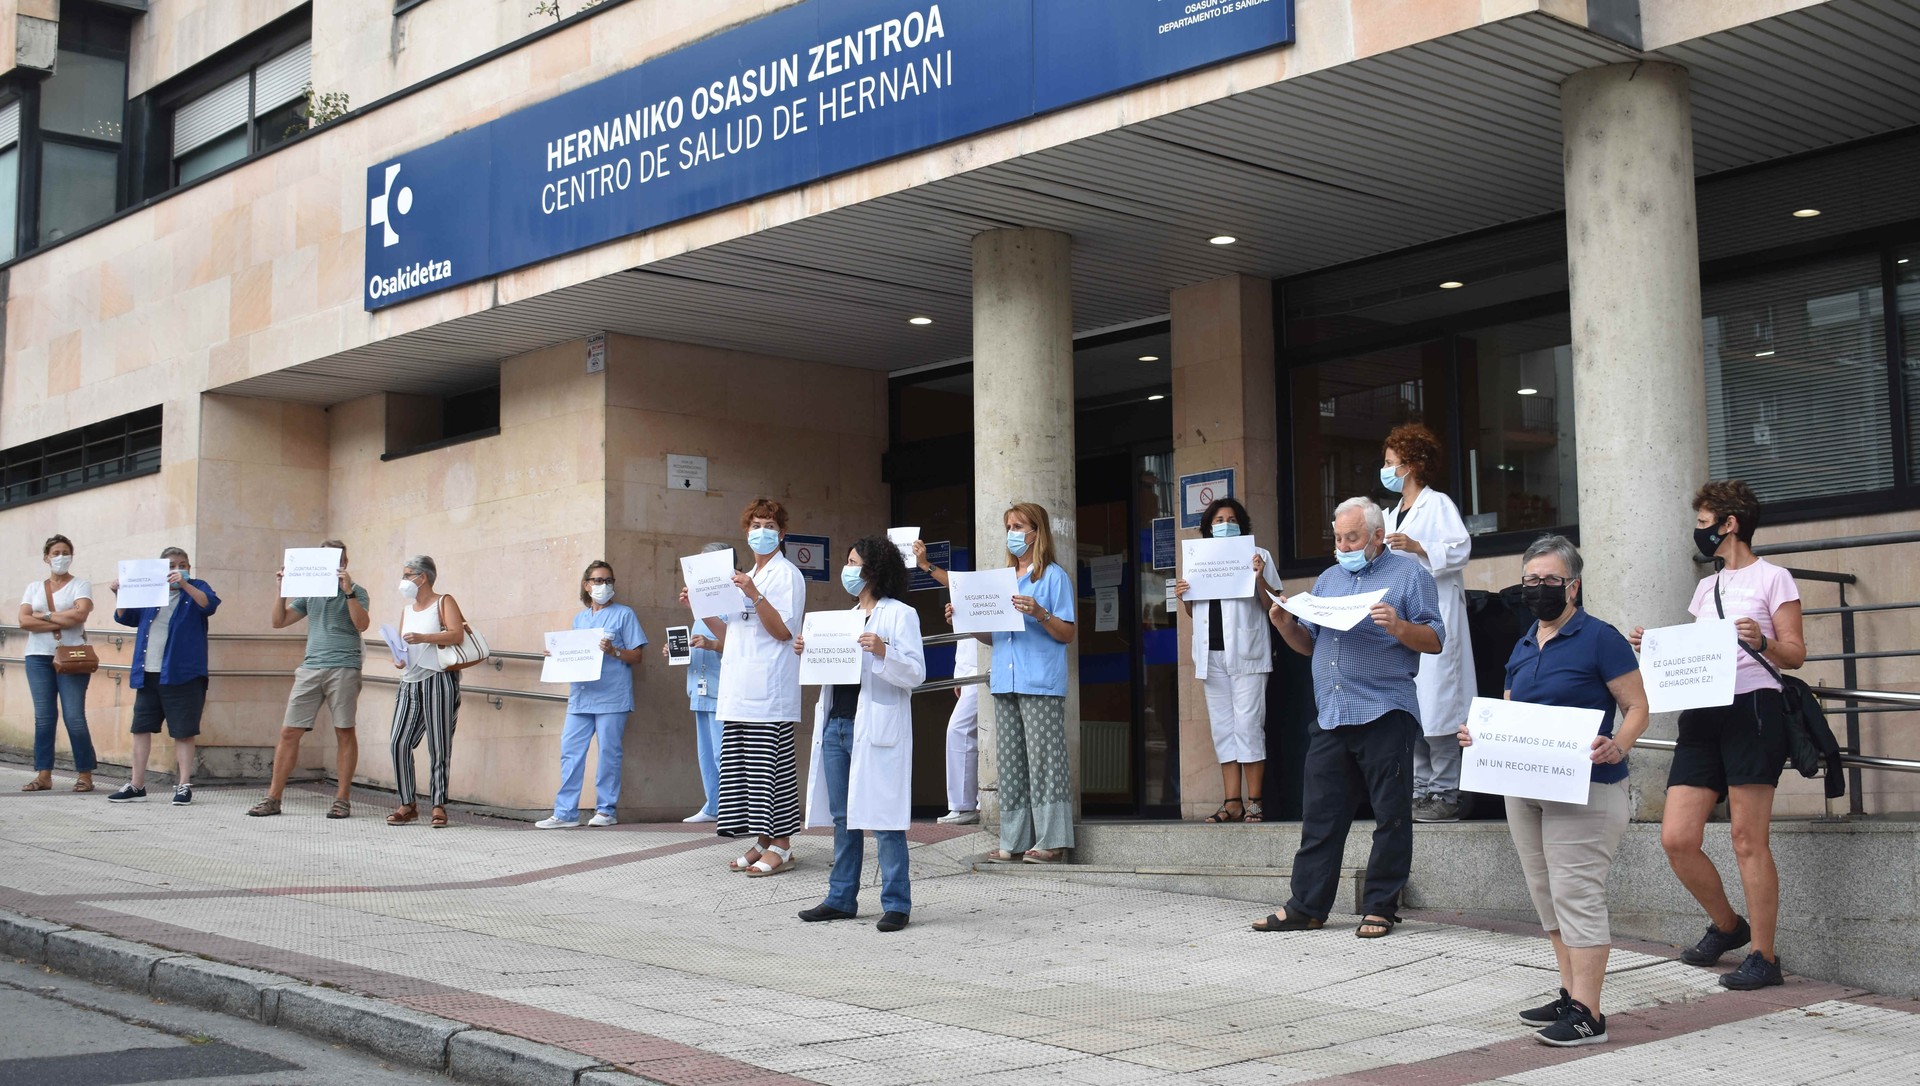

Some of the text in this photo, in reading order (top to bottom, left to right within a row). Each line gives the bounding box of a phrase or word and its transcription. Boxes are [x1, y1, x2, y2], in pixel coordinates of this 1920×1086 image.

[1158, 0, 1271, 34] DEPARTAMENTO DE SANID
[546, 4, 945, 172] HERNANIKO OSASUN ZENTROA
[541, 50, 952, 214] CENTRO DE SALUD DE HERNANI
[369, 259, 452, 299] Osakidetza
[1653, 653, 1722, 668] EZ GAUDE SOBERAN
[1665, 666, 1708, 677] MURRIZKETA
[1659, 675, 1714, 688] GEHIAGORIK EZ!
[1479, 732, 1493, 740] NO
[1495, 733, 1540, 746] ESTAMOS
[1541, 738, 1555, 747] DE
[1476, 758, 1488, 767] ¡NI
[1490, 760, 1503, 768] UN
[1505, 761, 1549, 774] RECORTE
